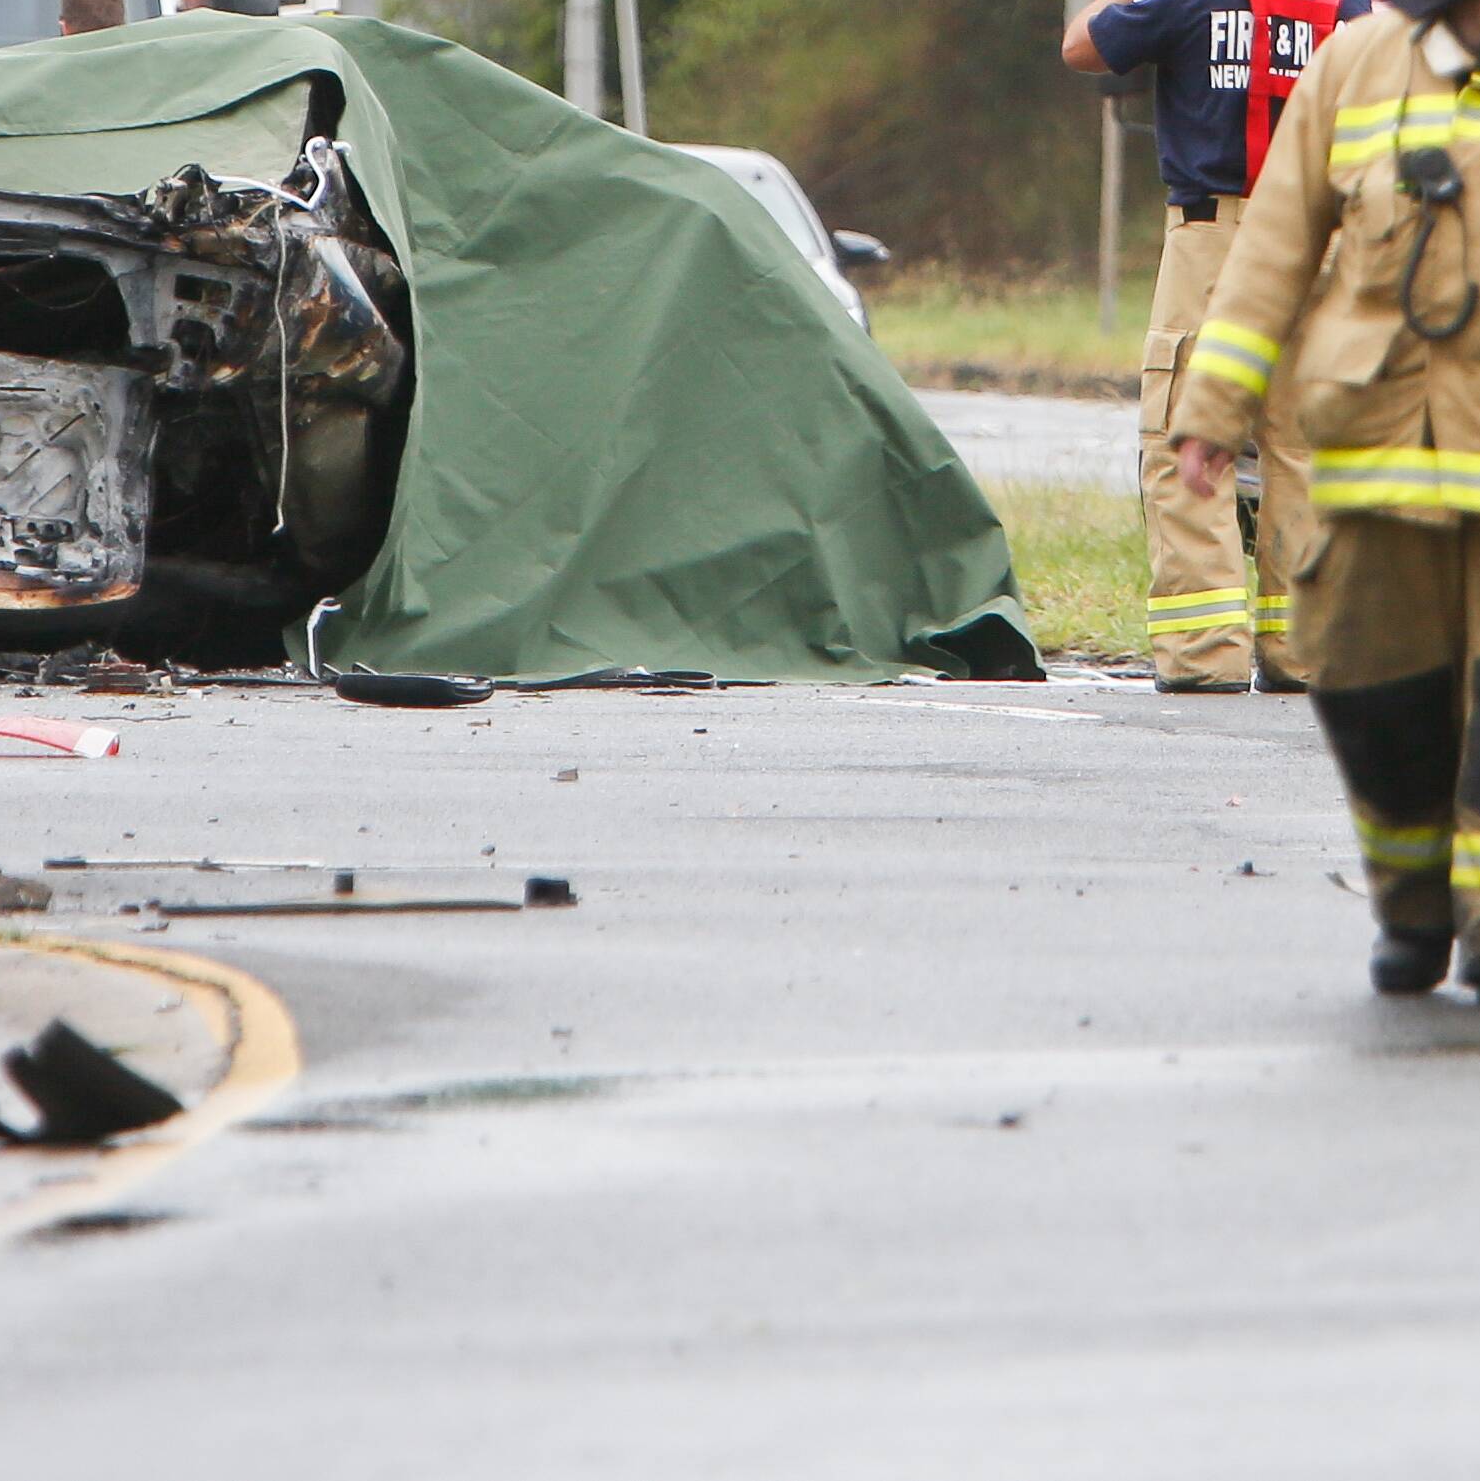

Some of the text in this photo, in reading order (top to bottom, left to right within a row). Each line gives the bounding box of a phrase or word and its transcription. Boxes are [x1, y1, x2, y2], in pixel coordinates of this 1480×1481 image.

[1210, 10, 1271, 61] FIR
[1276, 24, 1292, 56] &
[1210, 65, 1251, 89] NEW
